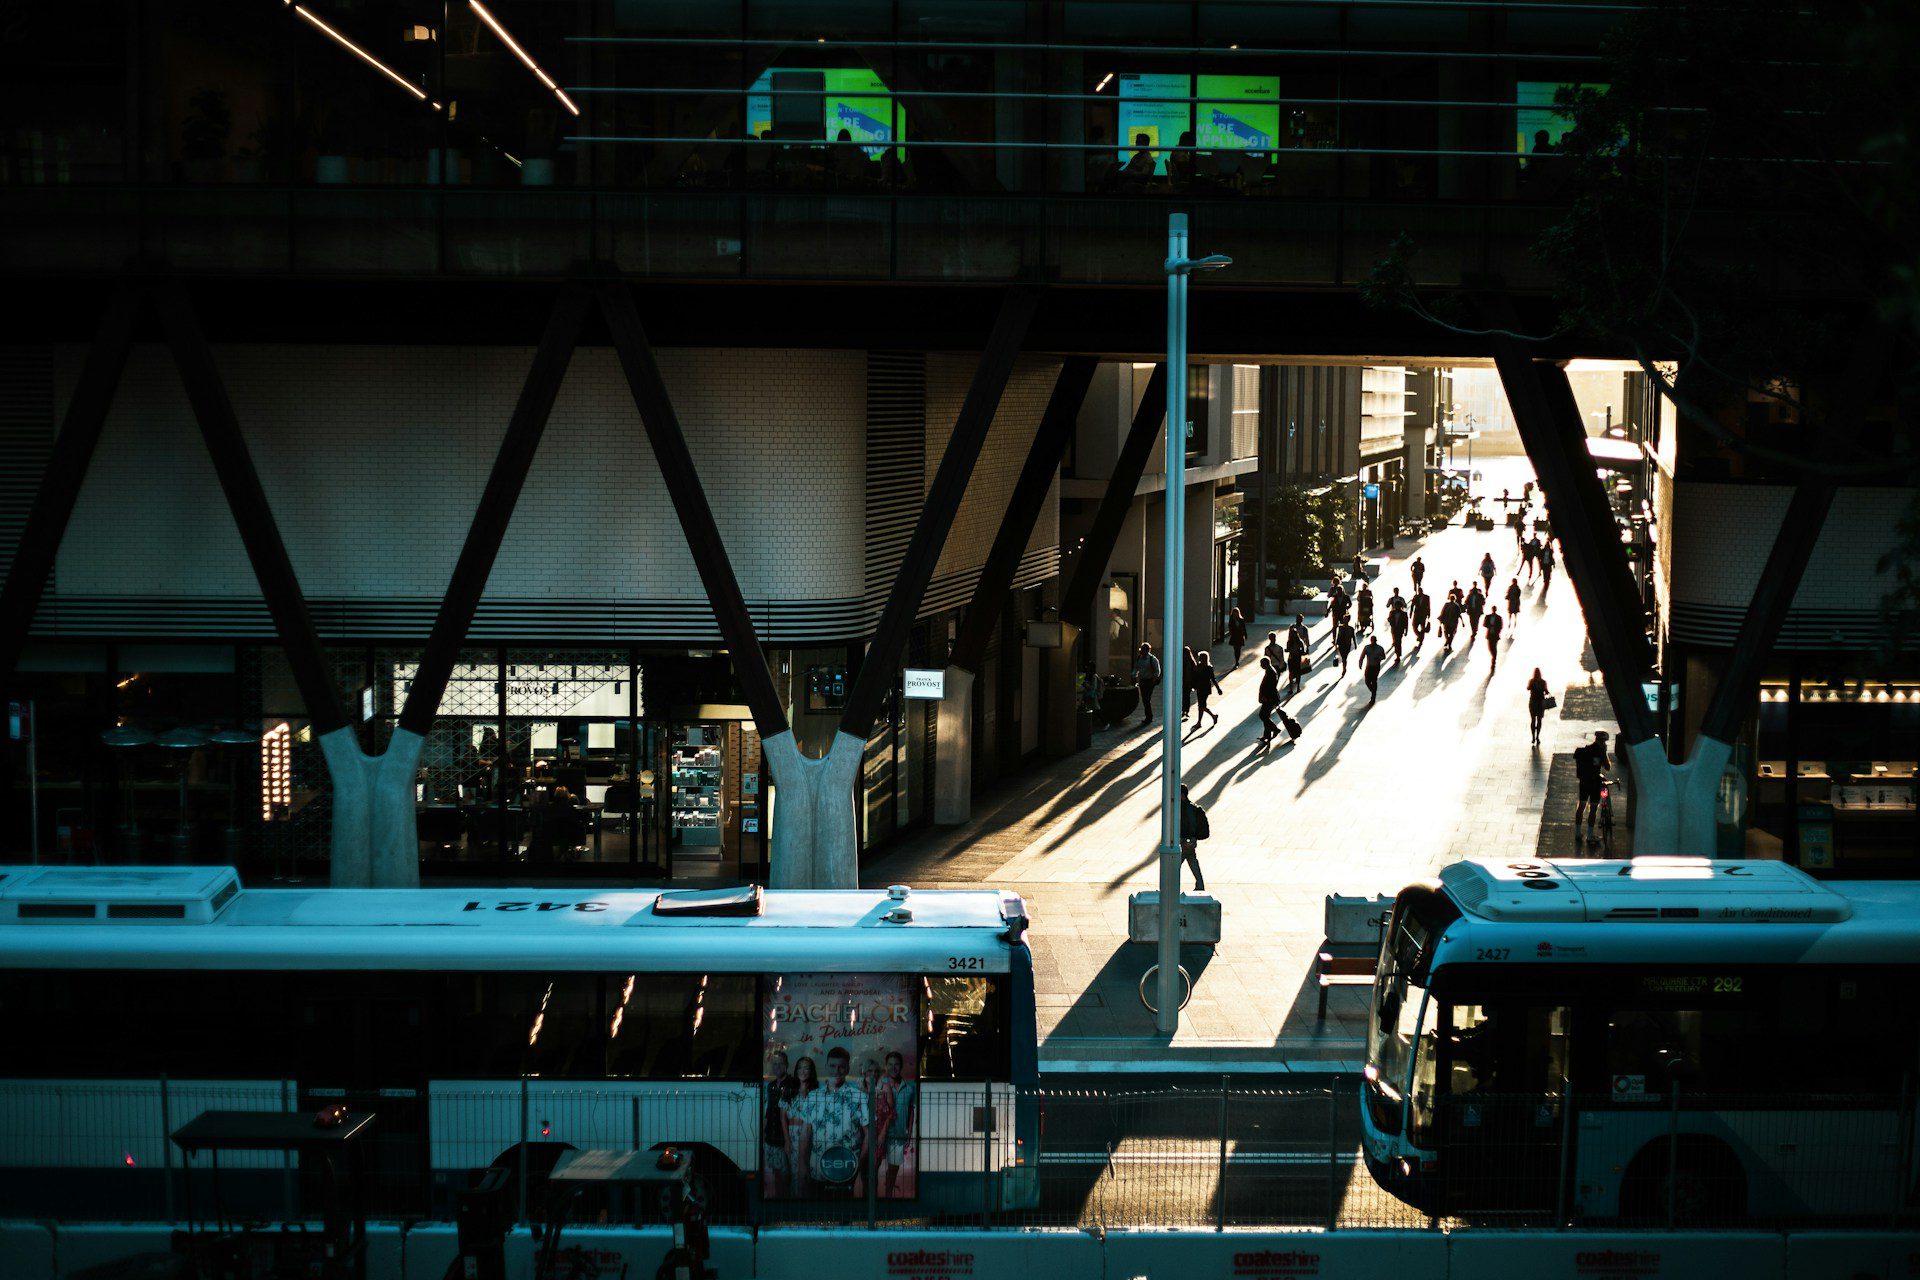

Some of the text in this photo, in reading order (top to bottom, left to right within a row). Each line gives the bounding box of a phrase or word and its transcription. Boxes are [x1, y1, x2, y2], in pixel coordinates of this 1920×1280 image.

[907, 680, 941, 688] PROVOST
[462, 901, 609, 912] 3421
[1718, 907, 1813, 919] Air Conditioned
[1476, 948, 1511, 961] 2427
[948, 957, 985, 970] 3421
[1712, 976, 1744, 993] 292
[774, 1001, 910, 1023] BACHELOR
[799, 1020, 886, 1043] in Paradise
[887, 1249, 975, 1266] coateshire
